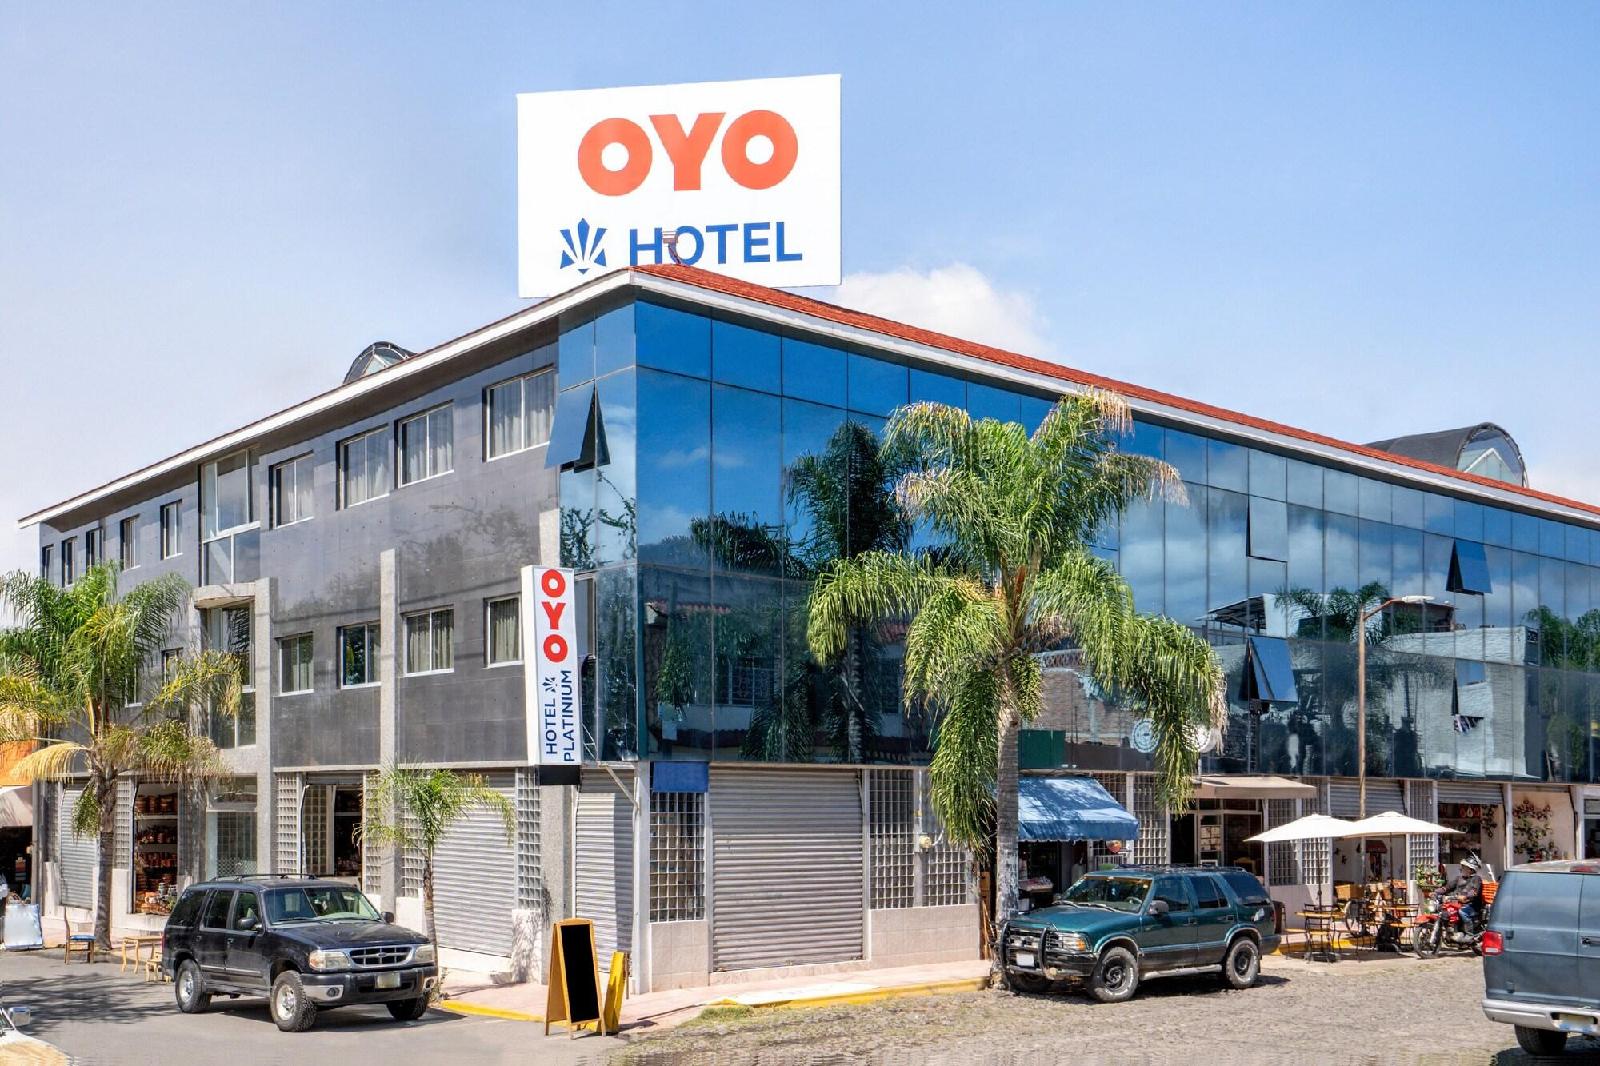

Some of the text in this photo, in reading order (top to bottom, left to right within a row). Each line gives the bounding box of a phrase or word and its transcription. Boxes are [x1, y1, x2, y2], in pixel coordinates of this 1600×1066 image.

[577, 109, 799, 197] OYO
[629, 221, 803, 267] HOTEL
[541, 568, 569, 663] OYO
[545, 698, 558, 755] HOTEL
[561, 669, 576, 762] PLATINIUM
